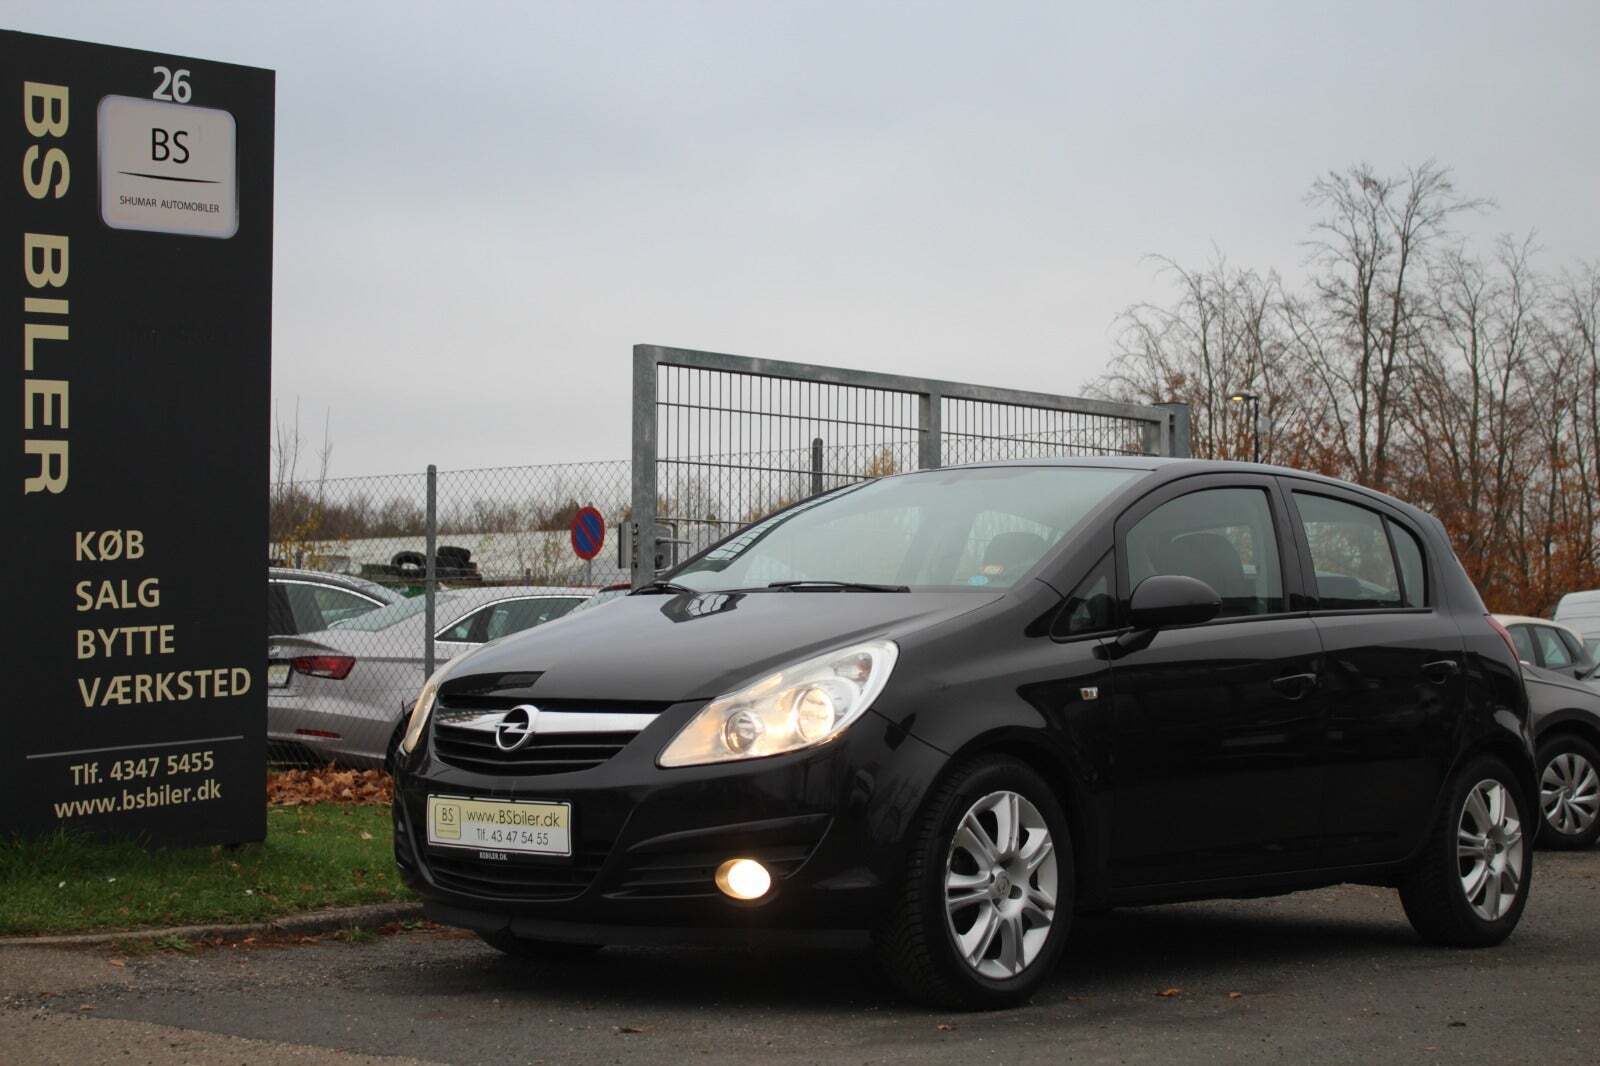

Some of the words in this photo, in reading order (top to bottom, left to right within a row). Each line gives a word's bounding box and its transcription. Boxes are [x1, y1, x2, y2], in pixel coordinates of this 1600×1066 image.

[152, 66, 192, 103] 26
[23, 81, 70, 199] BS
[151, 128, 190, 164] BS
[119, 195, 157, 208] SHUMAR
[160, 199, 220, 213] AUTOMOBILER
[24, 233, 69, 495] BILER
[75, 529, 145, 562] KØB
[76, 578, 160, 612] SALG
[77, 624, 175, 660] BYTTE
[78, 667, 251, 708] VÆRKSTED
[70, 762, 103, 786] Tlf.
[110, 757, 160, 781] 4347
[167, 751, 214, 775] 5455
[54, 779, 222, 818] www.bsbiler.dk
[441, 807, 454, 822] BS
[466, 809, 560, 828] www.BSbiler.dk
[491, 830, 503, 842] 43
[506, 831, 518, 844] 47
[521, 832, 533, 845] 54
[537, 833, 549, 846] 55
